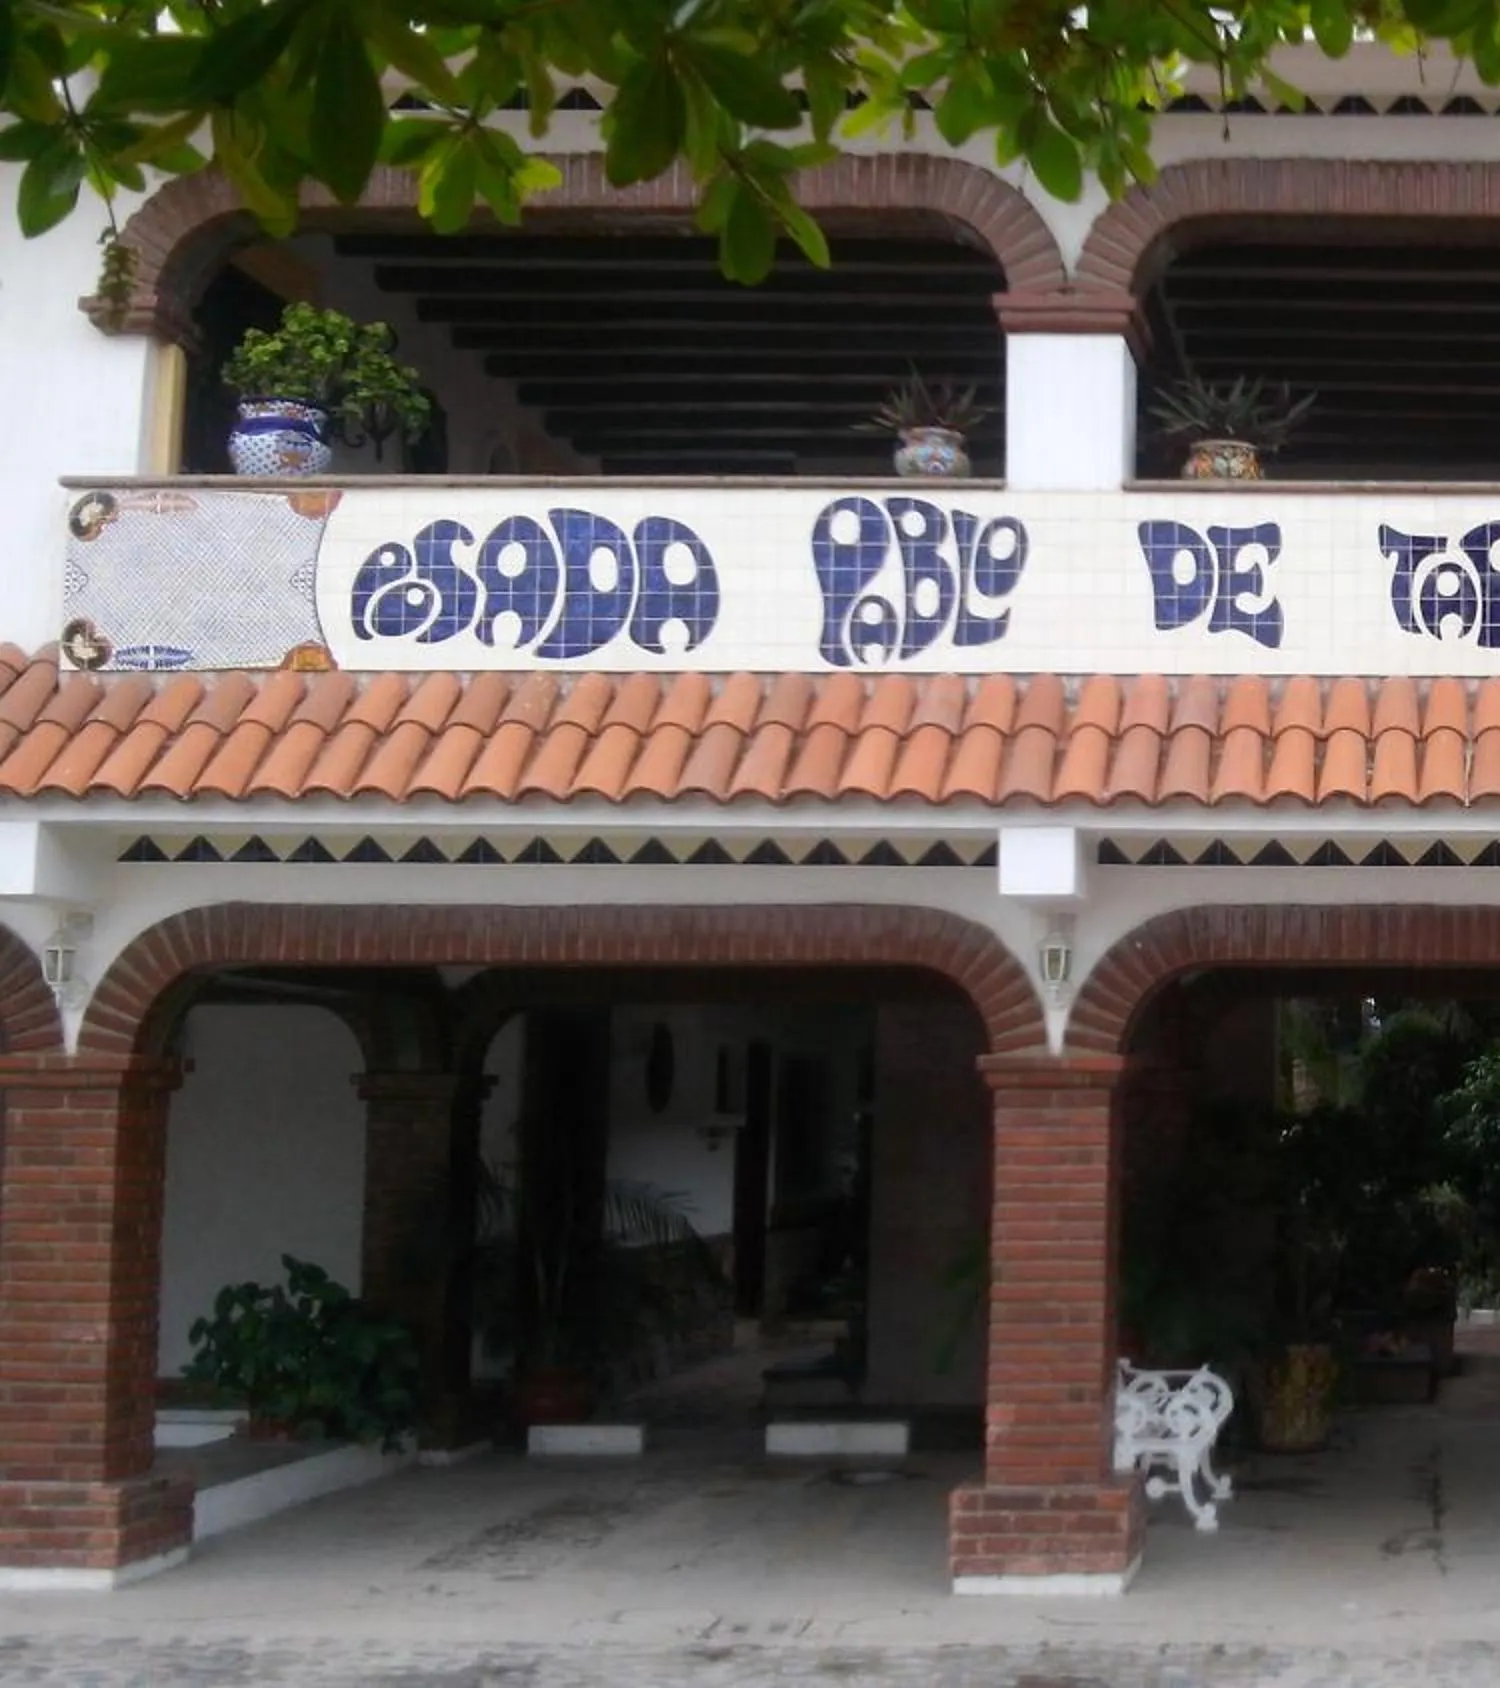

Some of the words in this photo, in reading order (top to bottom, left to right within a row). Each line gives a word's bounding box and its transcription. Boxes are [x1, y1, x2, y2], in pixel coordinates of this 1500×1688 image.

[350, 507, 721, 660] POSADA
[811, 495, 1030, 667] PABLO
[1137, 519, 1285, 649] DE
